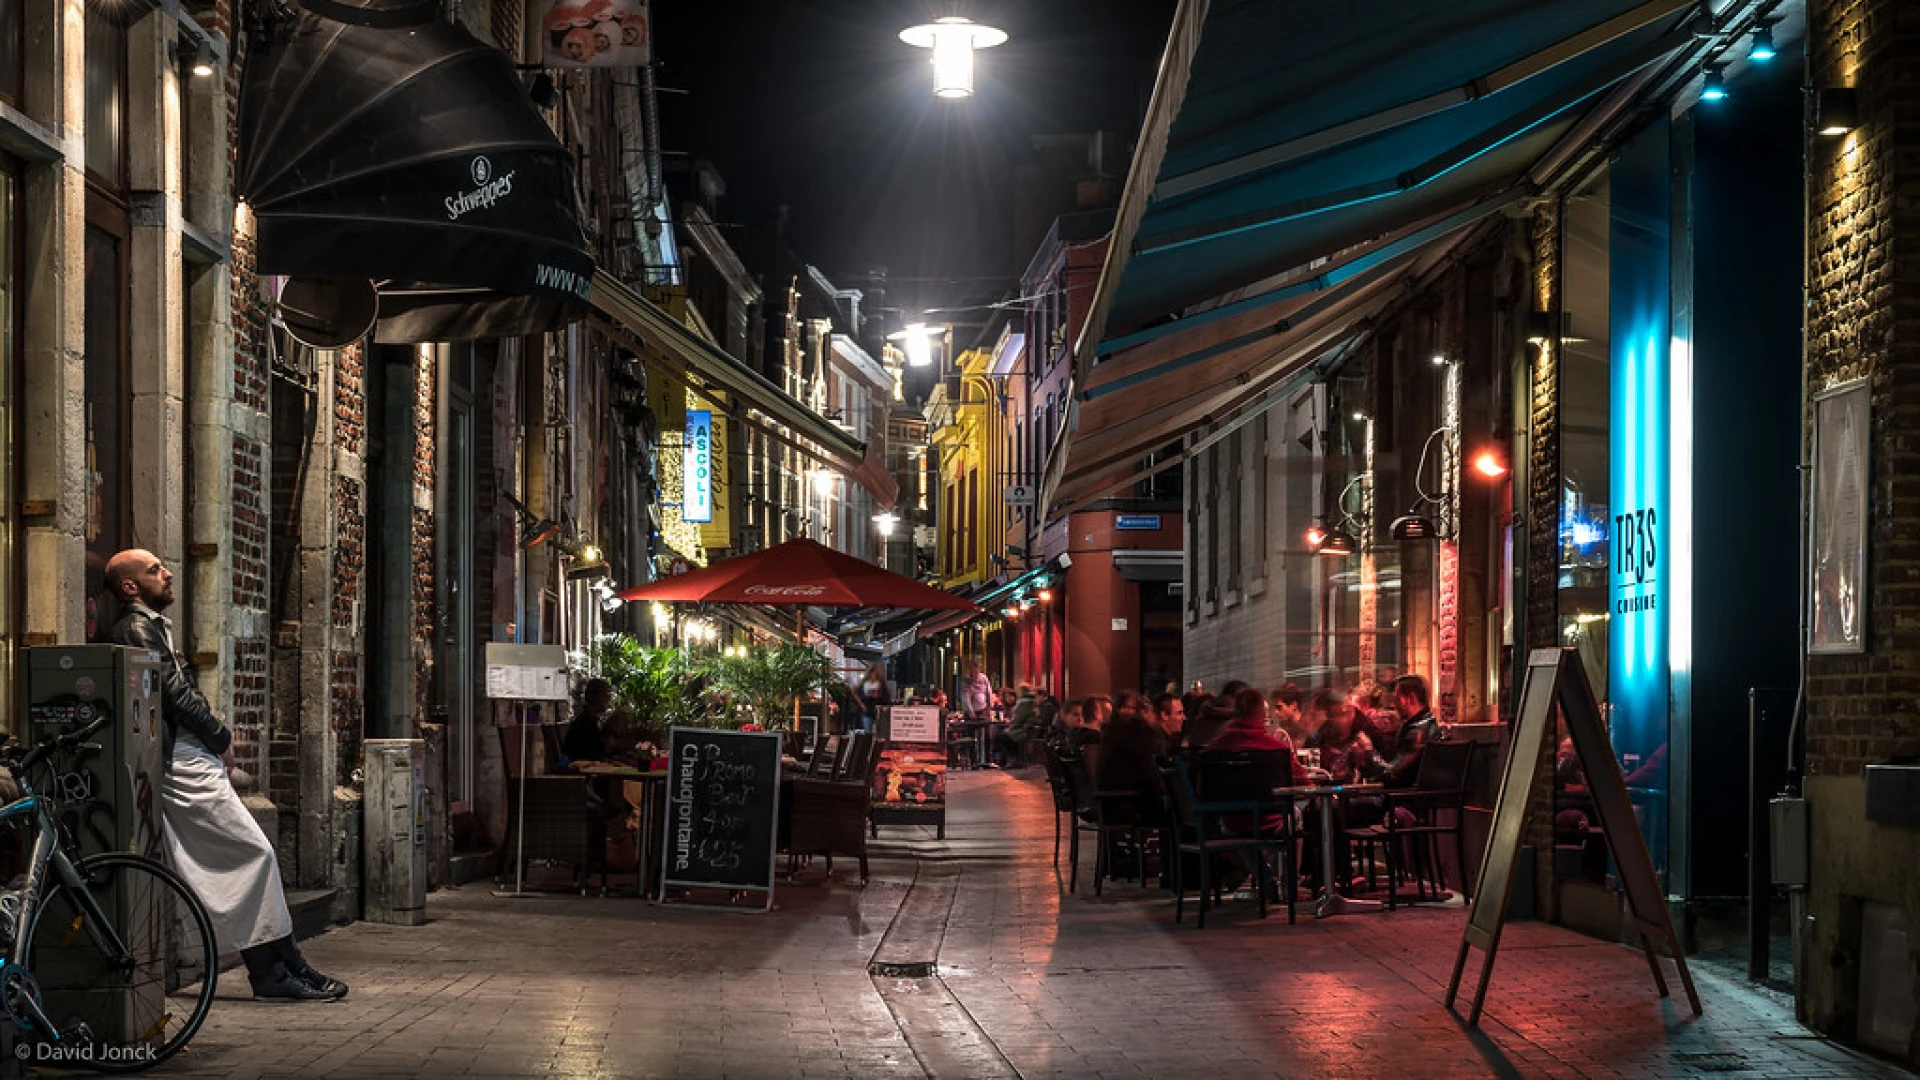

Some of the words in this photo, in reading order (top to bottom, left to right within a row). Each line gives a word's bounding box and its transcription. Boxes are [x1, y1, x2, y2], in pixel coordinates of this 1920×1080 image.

[445, 171, 515, 220] Schweppes
[695, 425, 708, 506] ASCOLI
[1615, 508, 1656, 583] TR3S
[1617, 593, 1656, 614] CUISINE
[672, 743, 699, 872] Chaudfontaine
